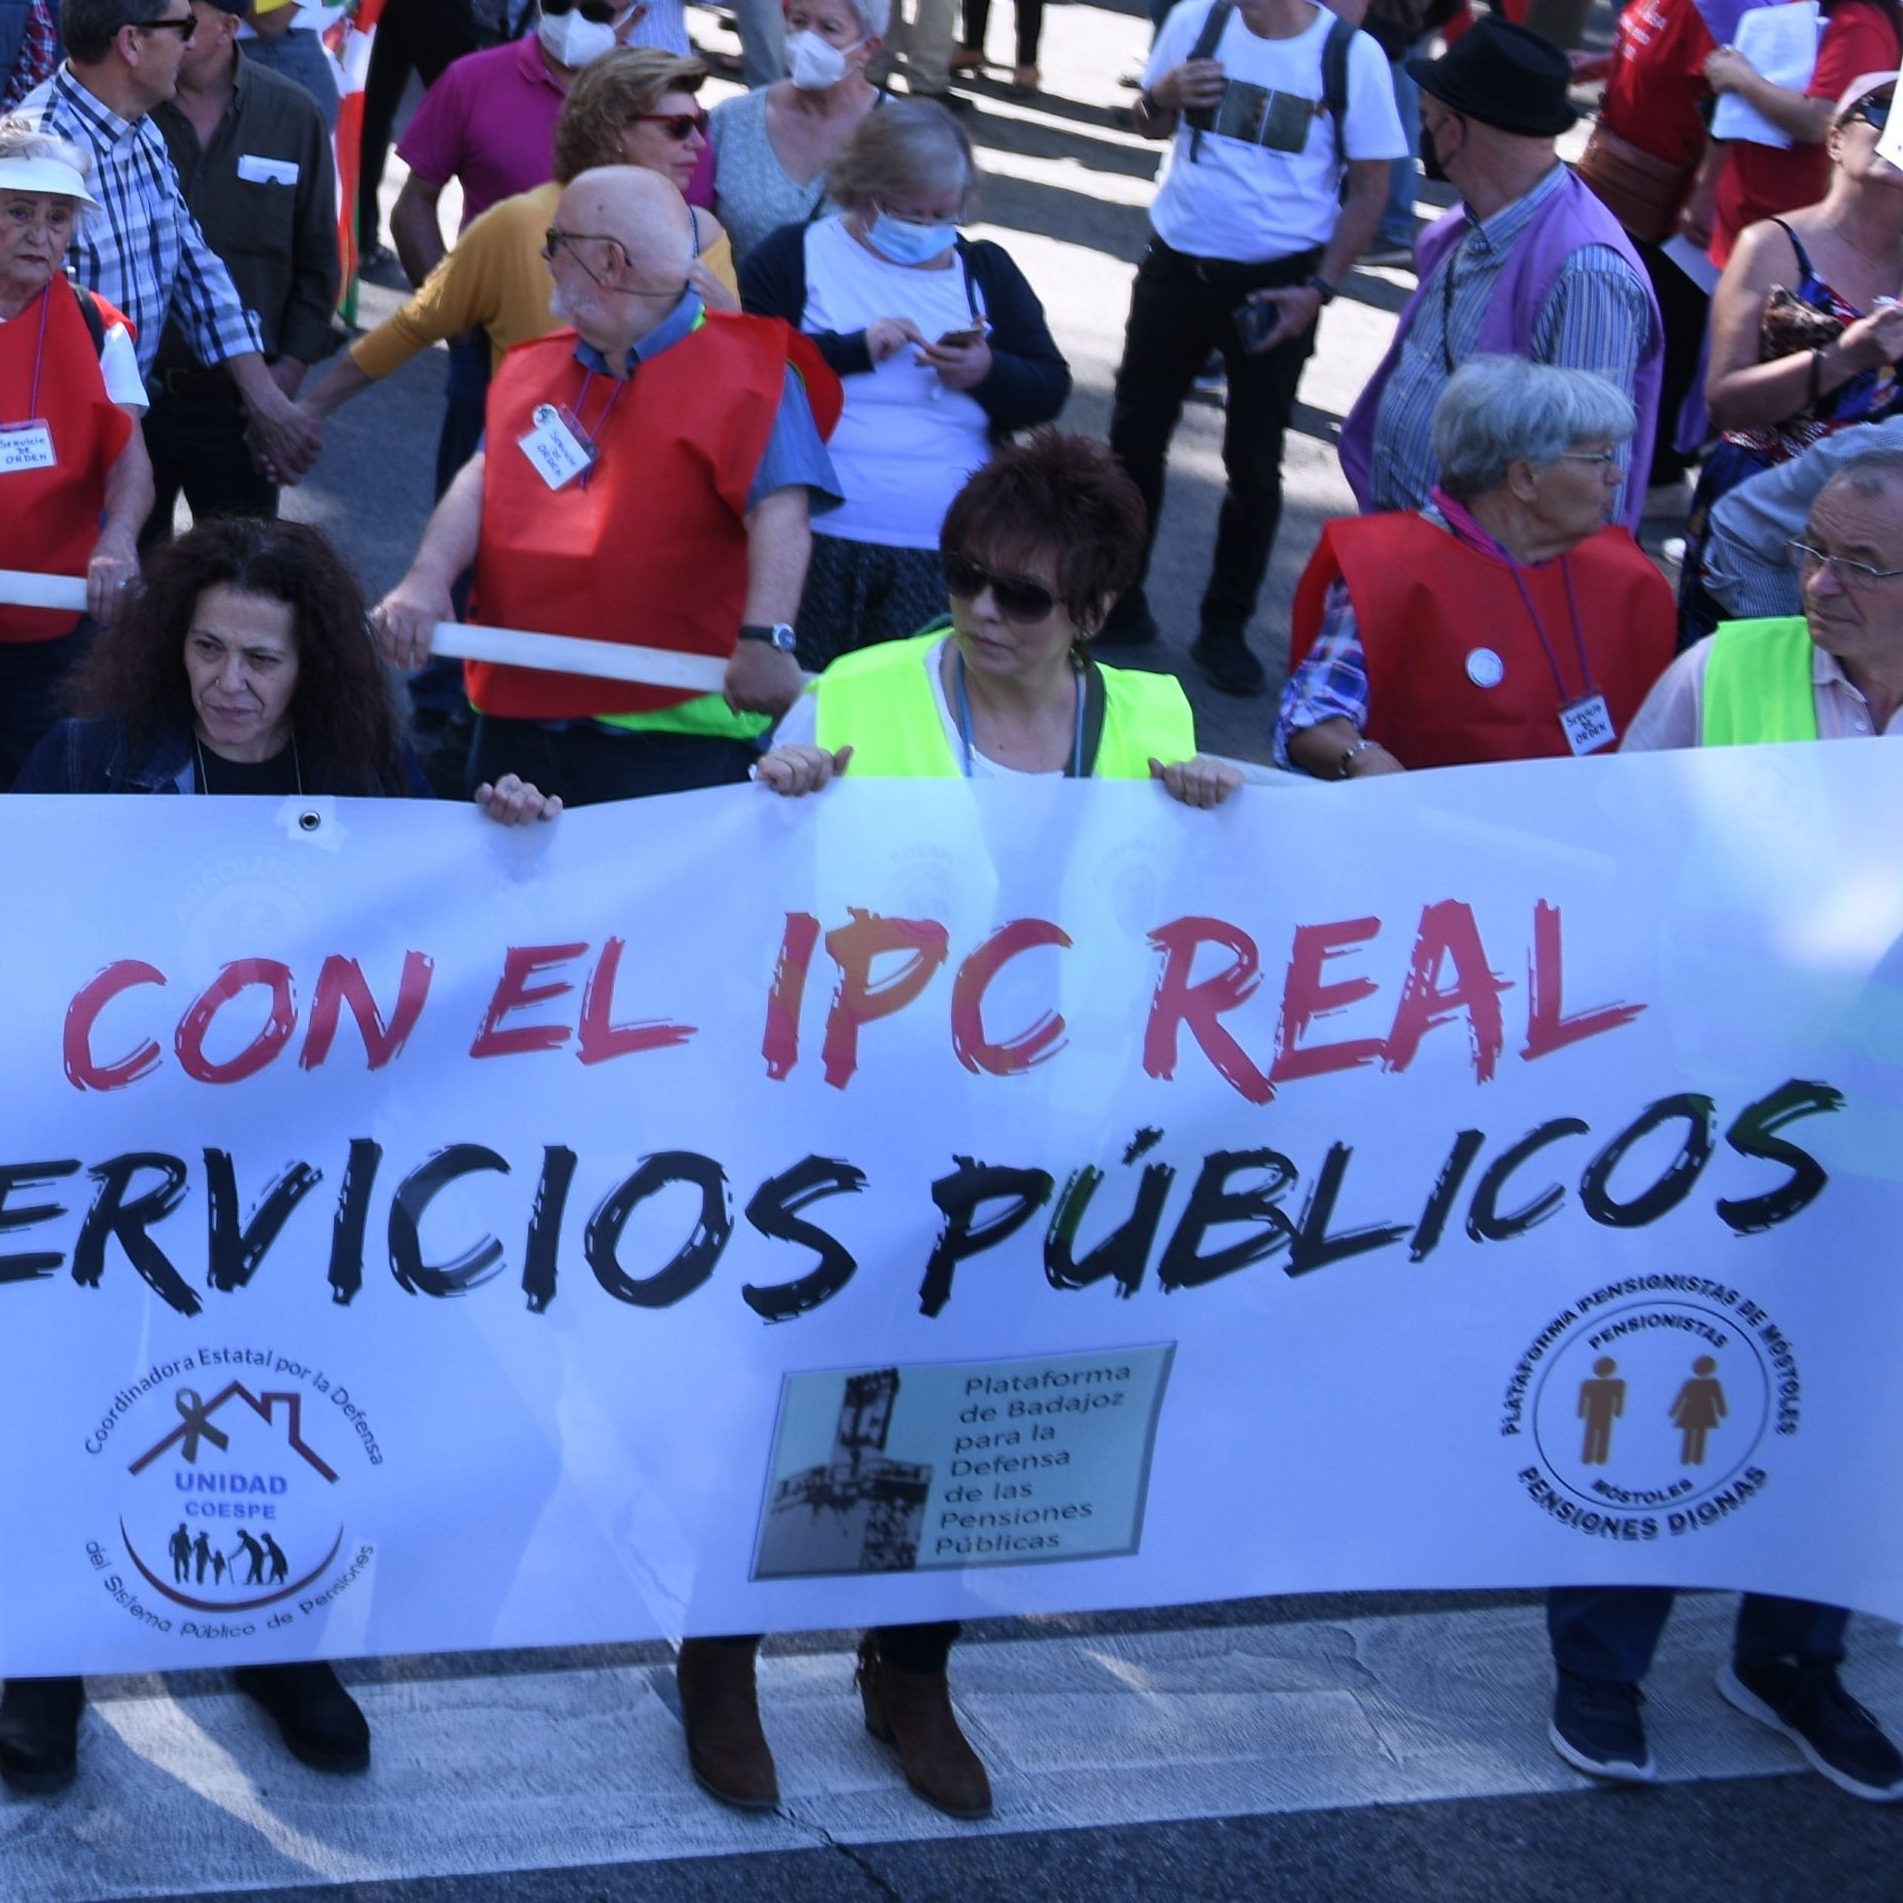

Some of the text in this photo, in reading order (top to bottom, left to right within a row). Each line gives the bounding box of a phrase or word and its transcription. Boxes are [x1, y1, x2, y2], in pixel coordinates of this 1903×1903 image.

[6, 454, 47, 464] ORDEN
[62, 948, 433, 1094] CON
[468, 935, 698, 1064] EL
[761, 904, 1073, 1091] IPC
[1140, 896, 1648, 1104] REAL
[917, 1079, 1847, 1317] PÚBLICOS
[1588, 1313, 1729, 1349] PENSIONISTAS
[1501, 1273, 1741, 1437] PLATAFORMA PENSIONISTAS
[964, 1364, 1131, 1397] Plataforma
[85, 1347, 383, 1465] Coordinadora Estatal por la Defensa
[958, 1391, 1125, 1424] de Badajoz
[953, 1424, 1056, 1453] para la
[950, 1450, 1071, 1478] Defensa
[175, 1471, 288, 1496] UNIDAD
[943, 1482, 1033, 1504] de las
[185, 1501, 276, 1520] COESPE
[939, 1501, 1093, 1529] Pensiones
[1518, 1465, 1768, 1542] PENSIONES DIGNAS
[267, 1611, 293, 1630] de
